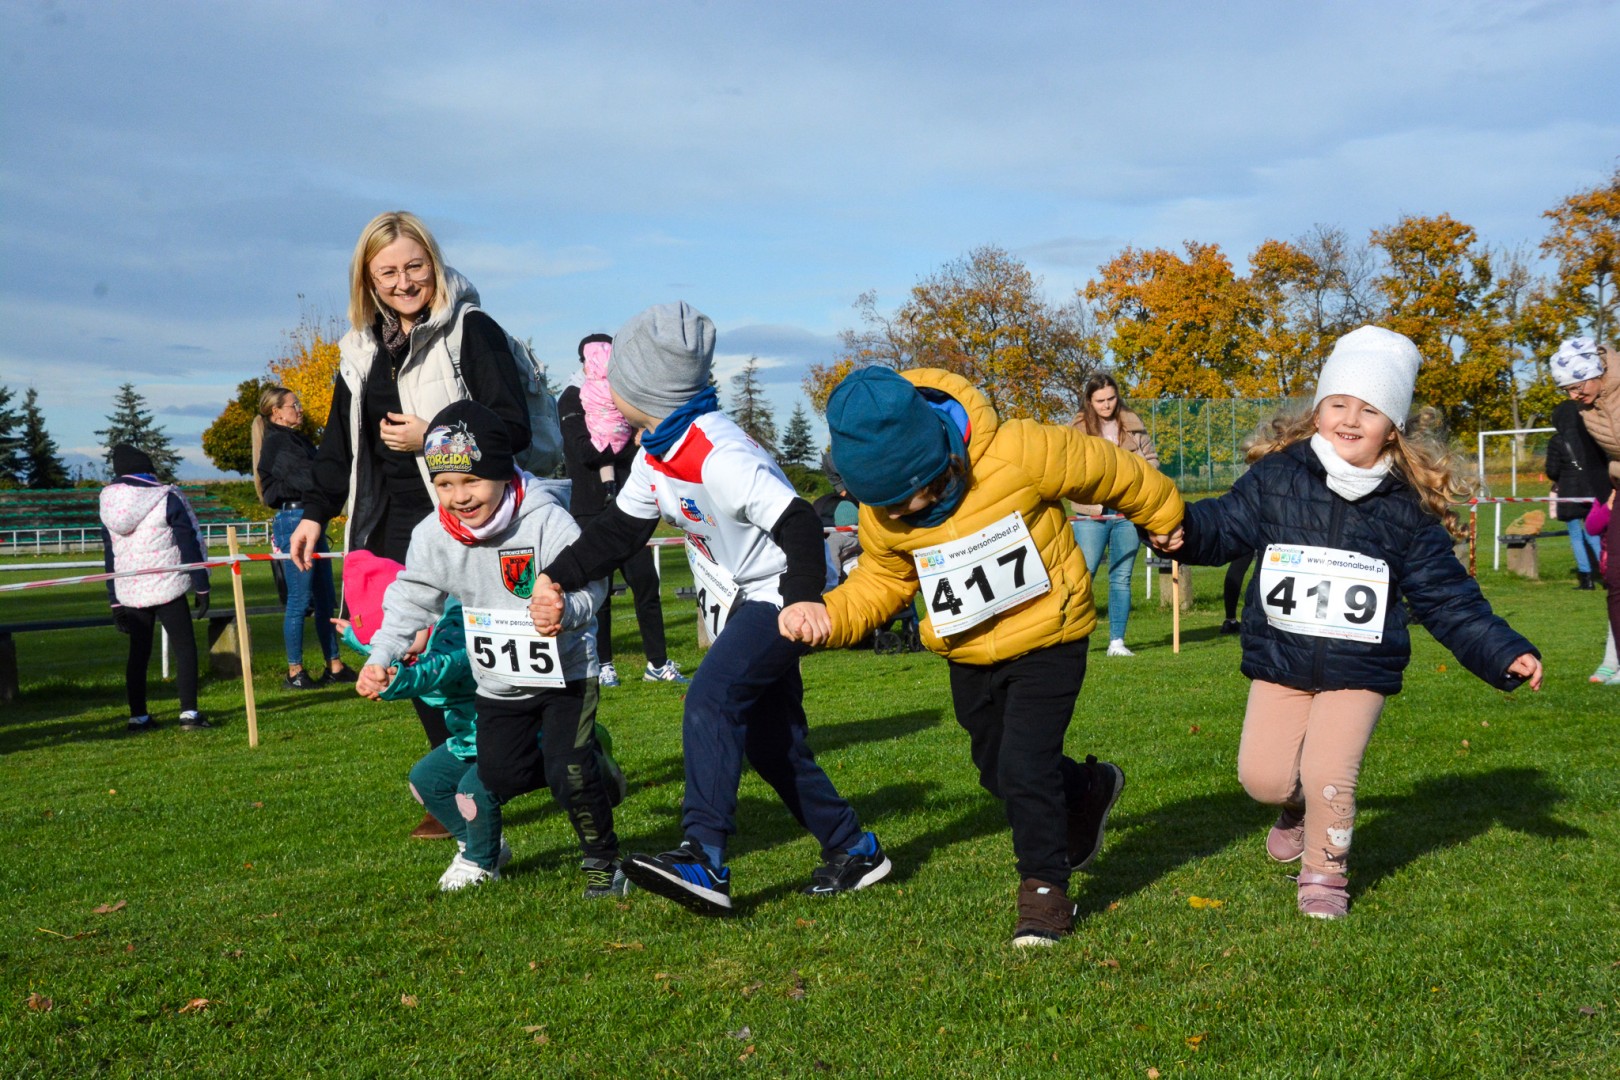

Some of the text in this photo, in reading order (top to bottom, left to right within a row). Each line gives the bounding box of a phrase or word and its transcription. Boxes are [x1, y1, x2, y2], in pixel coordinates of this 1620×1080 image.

[948, 522, 1021, 560] www.personalbest.pl
[696, 561, 734, 599] www.personalbest.pl
[931, 545, 1028, 616] 417
[1307, 556, 1384, 574] www.personalbest.pl
[698, 586, 721, 637] 41
[1266, 576, 1378, 625] 419
[495, 618, 534, 627] www.persona
[474, 635, 555, 675] 515
